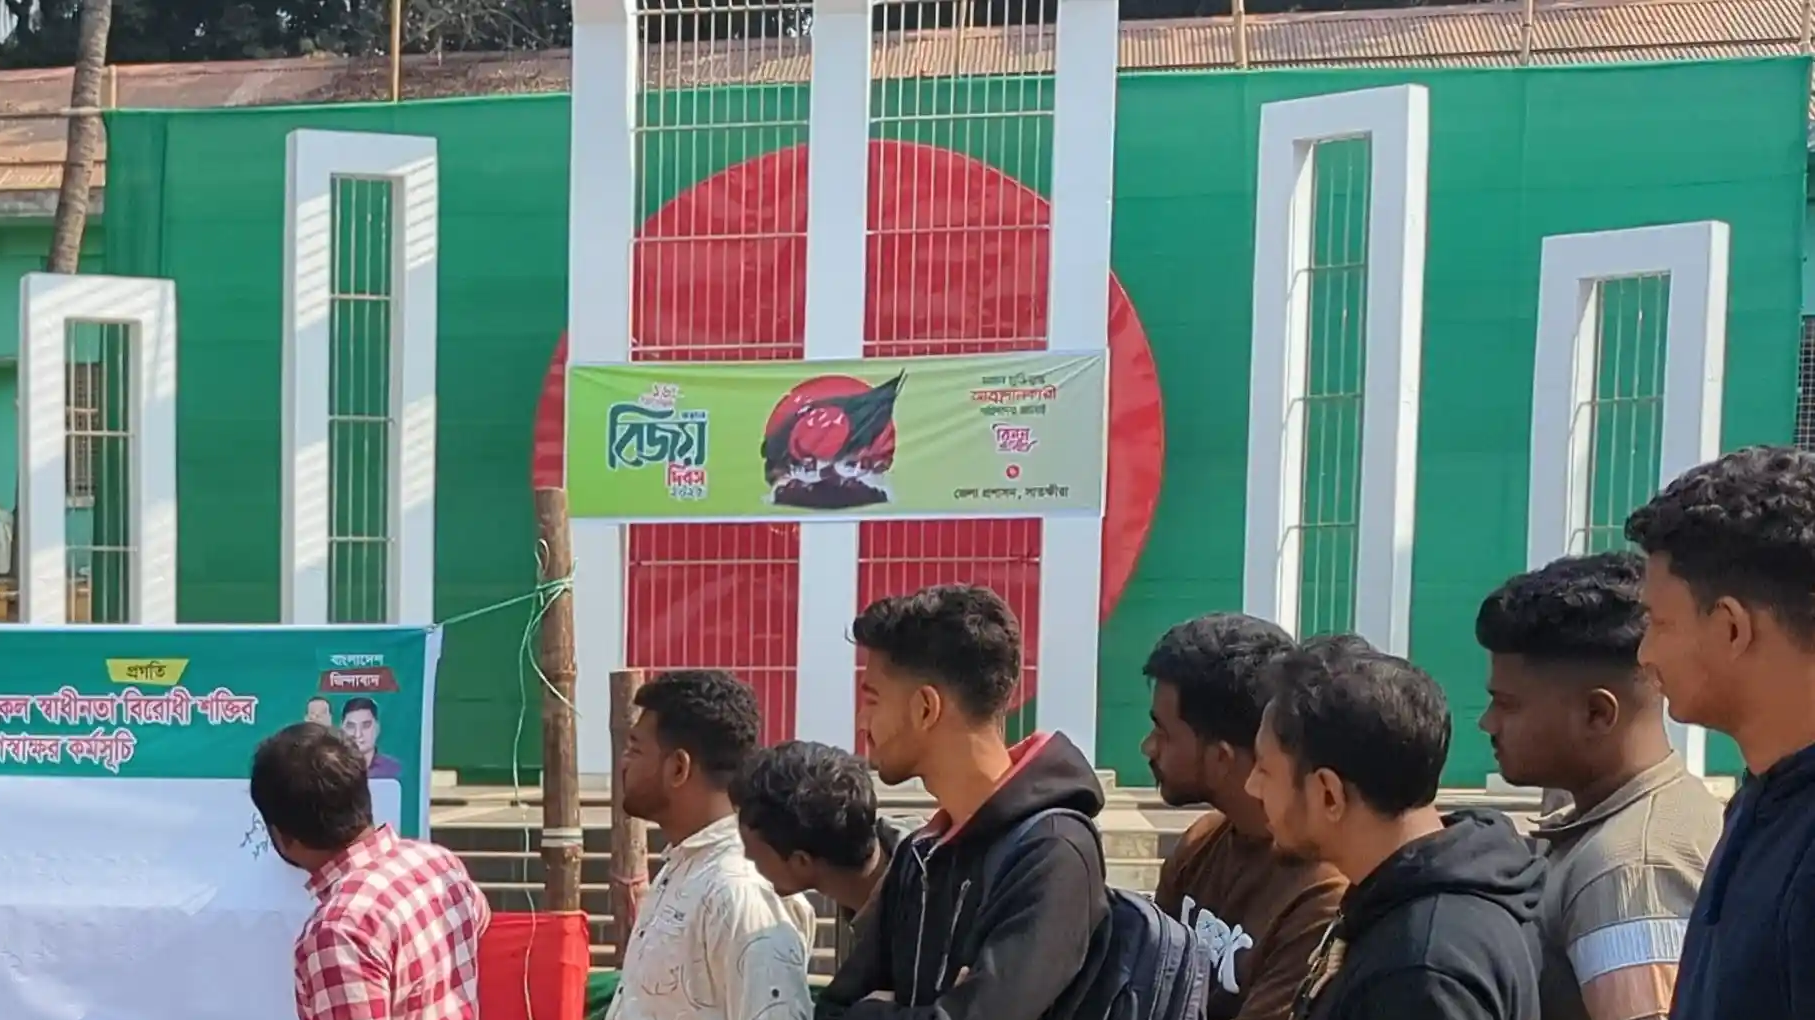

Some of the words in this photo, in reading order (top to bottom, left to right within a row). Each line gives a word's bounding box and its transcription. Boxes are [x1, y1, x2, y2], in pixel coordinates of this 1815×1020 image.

[608, 403, 706, 470] বিজয়
[125, 660, 167, 680] প্রগতি
[34, 685, 118, 725] স্বাধীনতা
[121, 686, 192, 726] বিরোধী
[195, 686, 258, 725] শক্তির
[65, 726, 138, 774] কর্মসূচি
